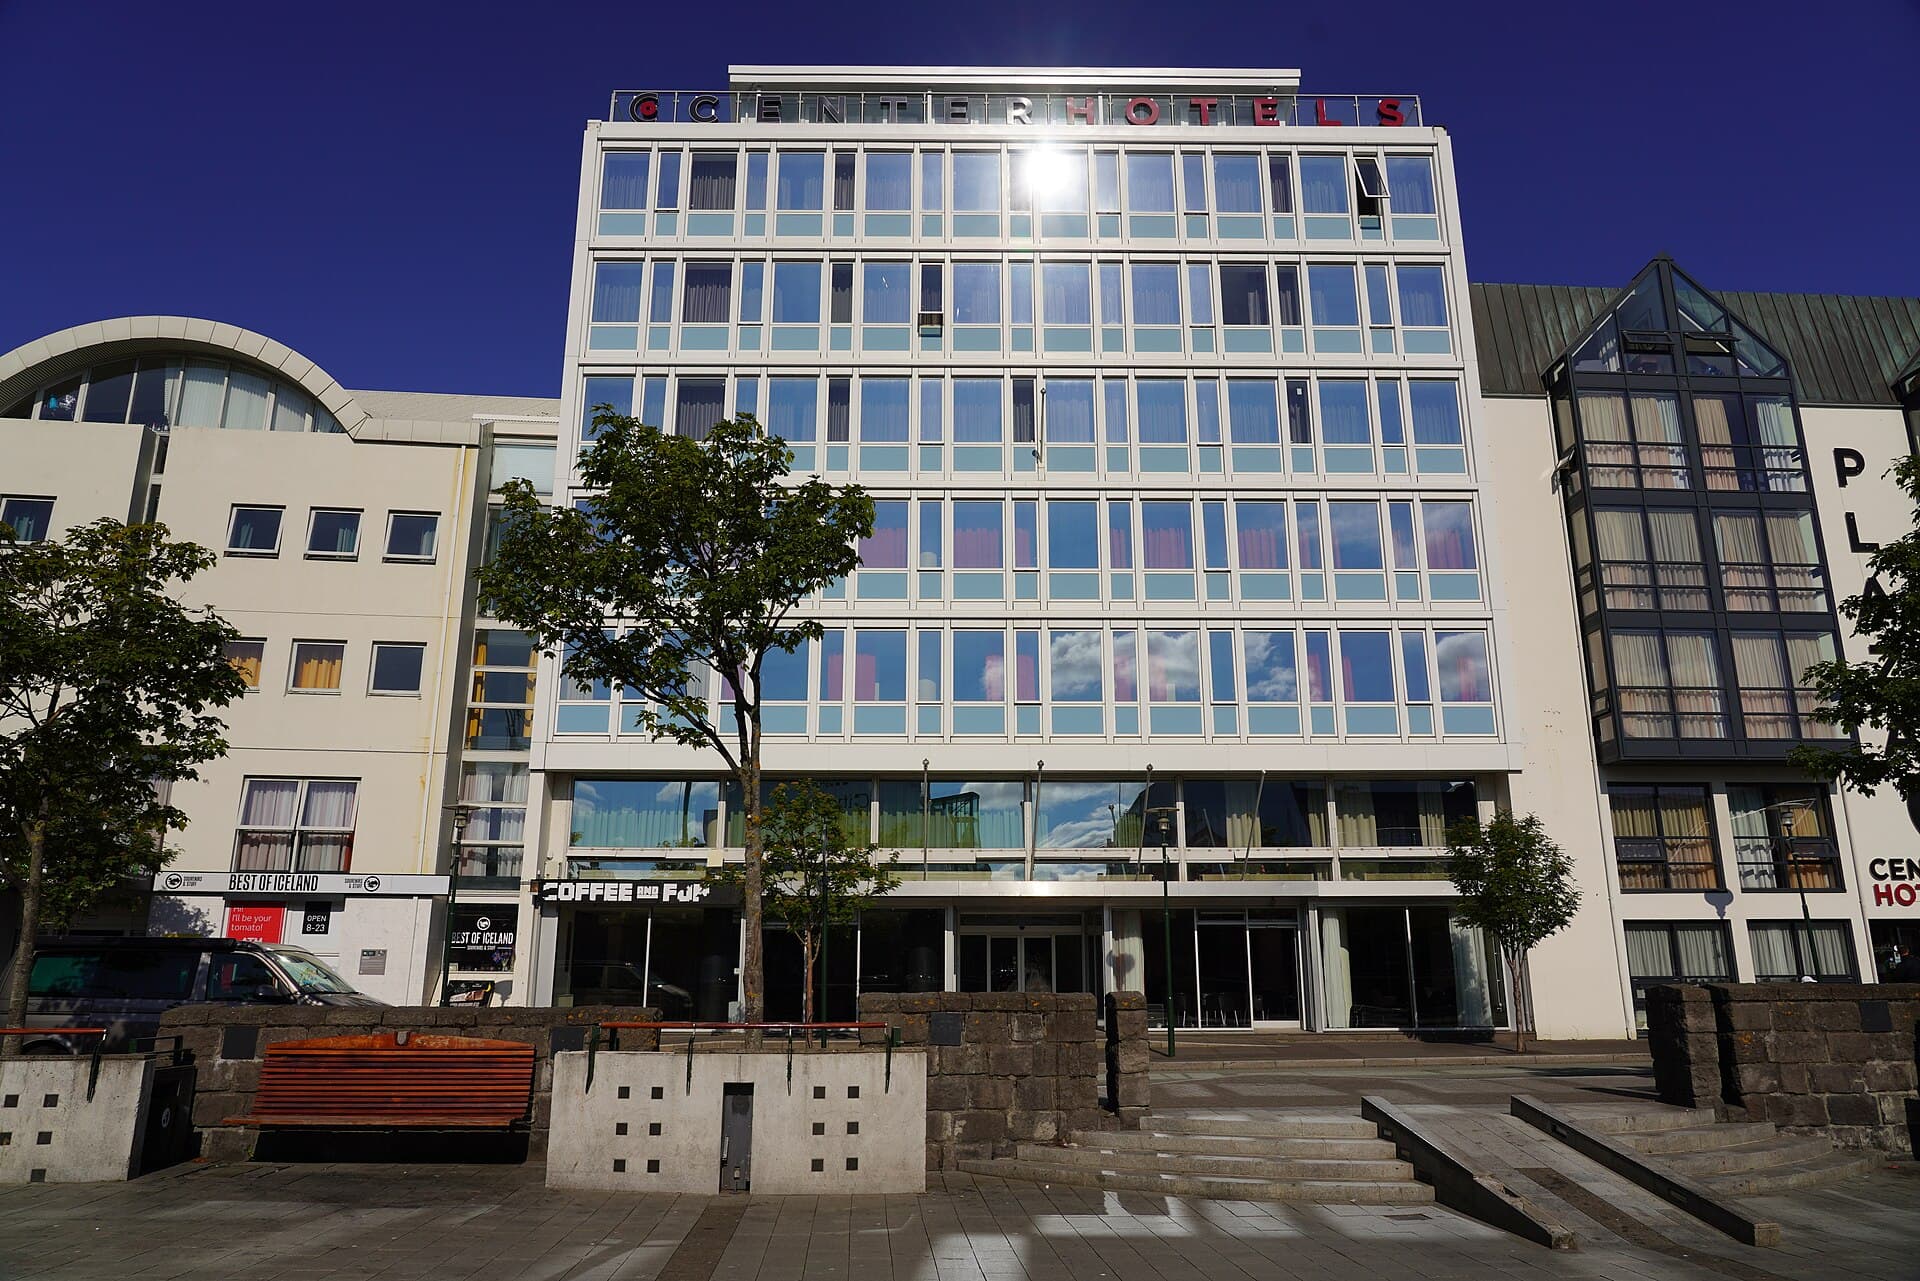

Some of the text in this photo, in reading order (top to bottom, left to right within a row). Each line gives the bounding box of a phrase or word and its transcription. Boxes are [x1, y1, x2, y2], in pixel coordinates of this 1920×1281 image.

[229, 874, 319, 892] BEST OF ICELAND
[542, 882, 634, 901] COFFEE
[636, 885, 659, 899] AND
[241, 914, 252, 922] be
[254, 915, 272, 923] your
[231, 923, 263, 932] tomato!
[306, 923, 325, 932] 8-23
[451, 932, 514, 945] BEST OF ICELAND
